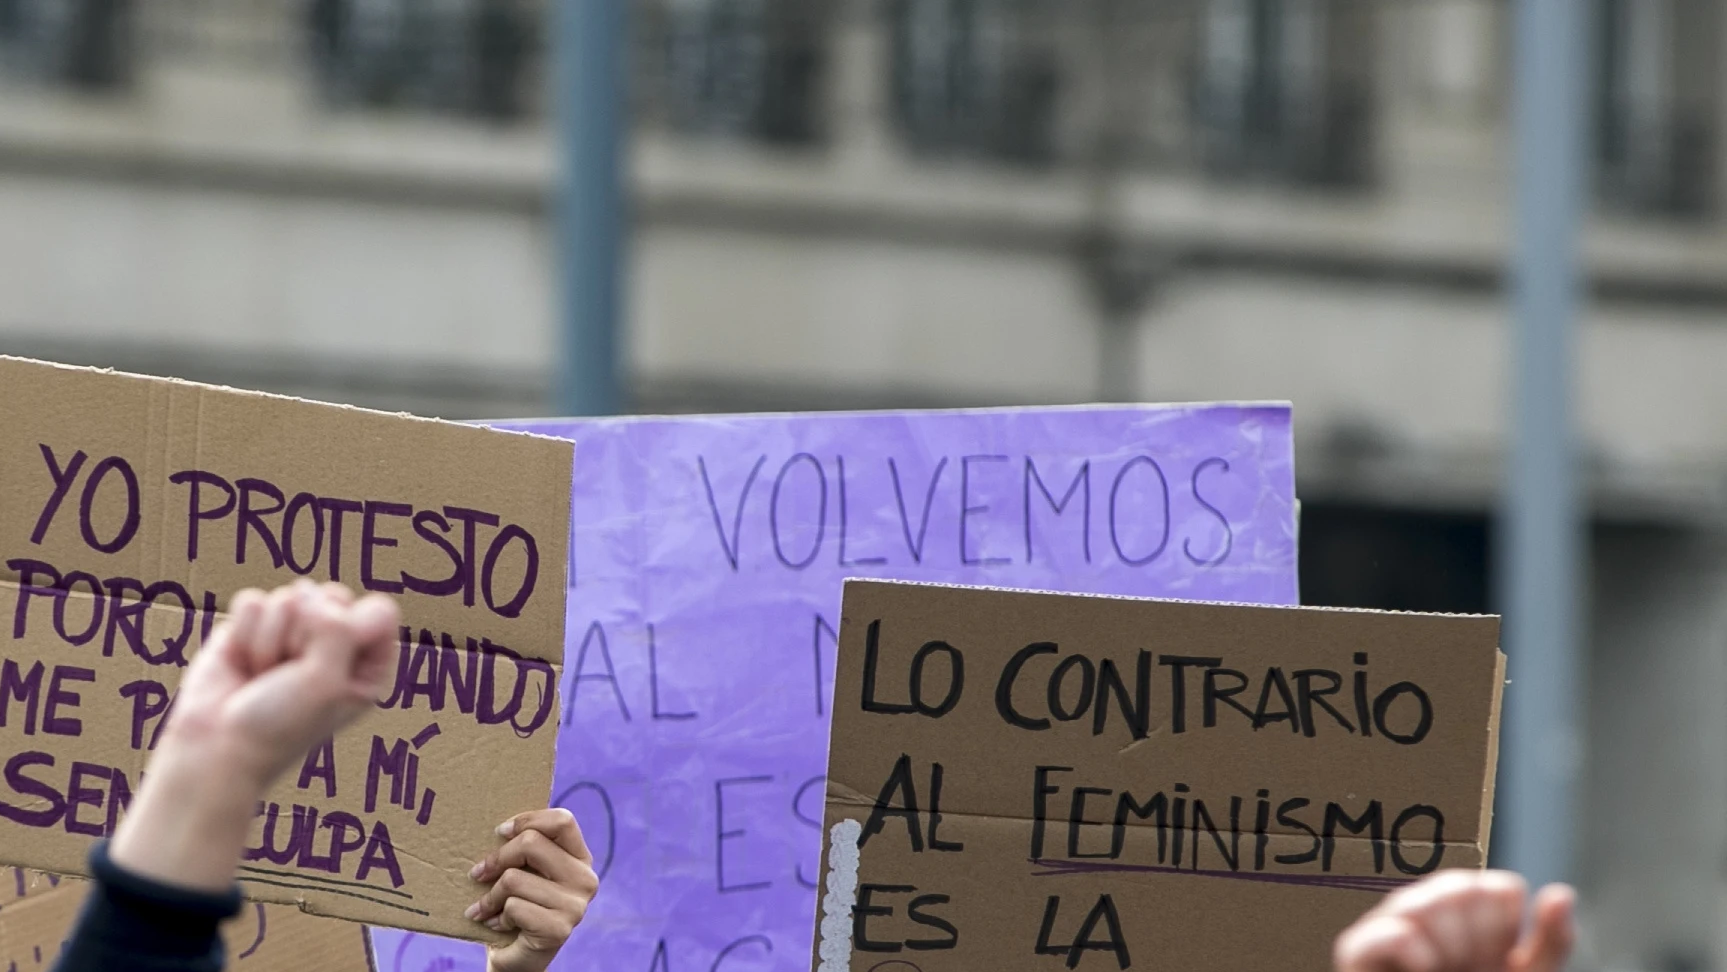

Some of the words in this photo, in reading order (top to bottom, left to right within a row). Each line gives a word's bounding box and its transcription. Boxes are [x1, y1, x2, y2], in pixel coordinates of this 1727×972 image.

[29, 443, 140, 554] YO
[168, 470, 539, 618] PROTESTO
[697, 452, 1233, 573] VOLVEMOS
[861, 619, 964, 718] LO
[857, 753, 964, 853] AL
[852, 884, 959, 951] ES
[1035, 893, 1131, 970] LA
